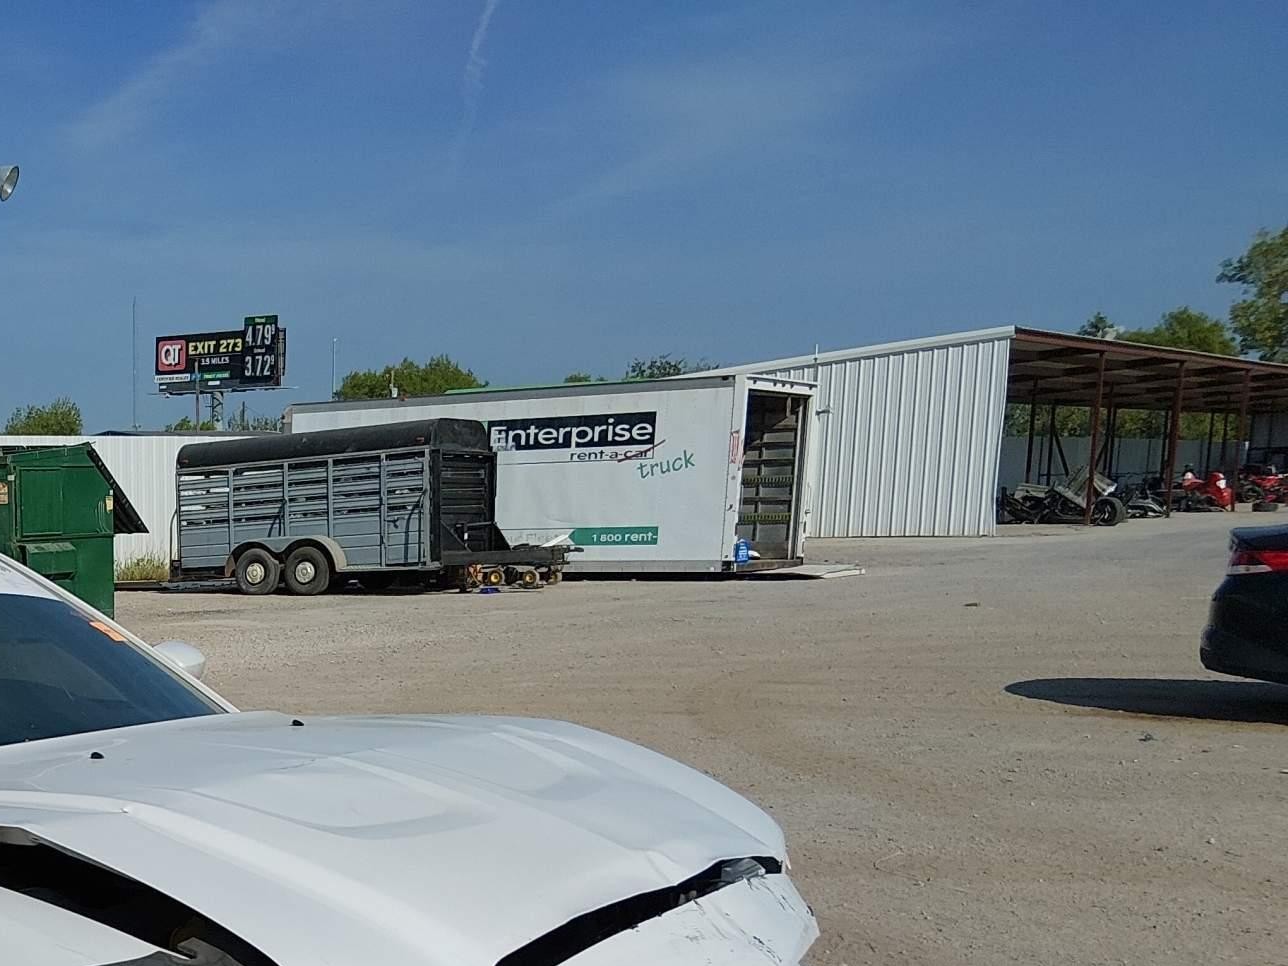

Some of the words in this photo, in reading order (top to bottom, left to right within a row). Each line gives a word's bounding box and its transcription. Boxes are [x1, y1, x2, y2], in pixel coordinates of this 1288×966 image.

[161, 345, 181, 366] QT
[188, 341, 216, 355] EXIT
[219, 339, 243, 353] 273
[490, 417, 653, 449] Enterprise
[570, 449, 651, 461] rent-a-car
[637, 449, 695, 479] truck
[600, 533, 622, 543] 800
